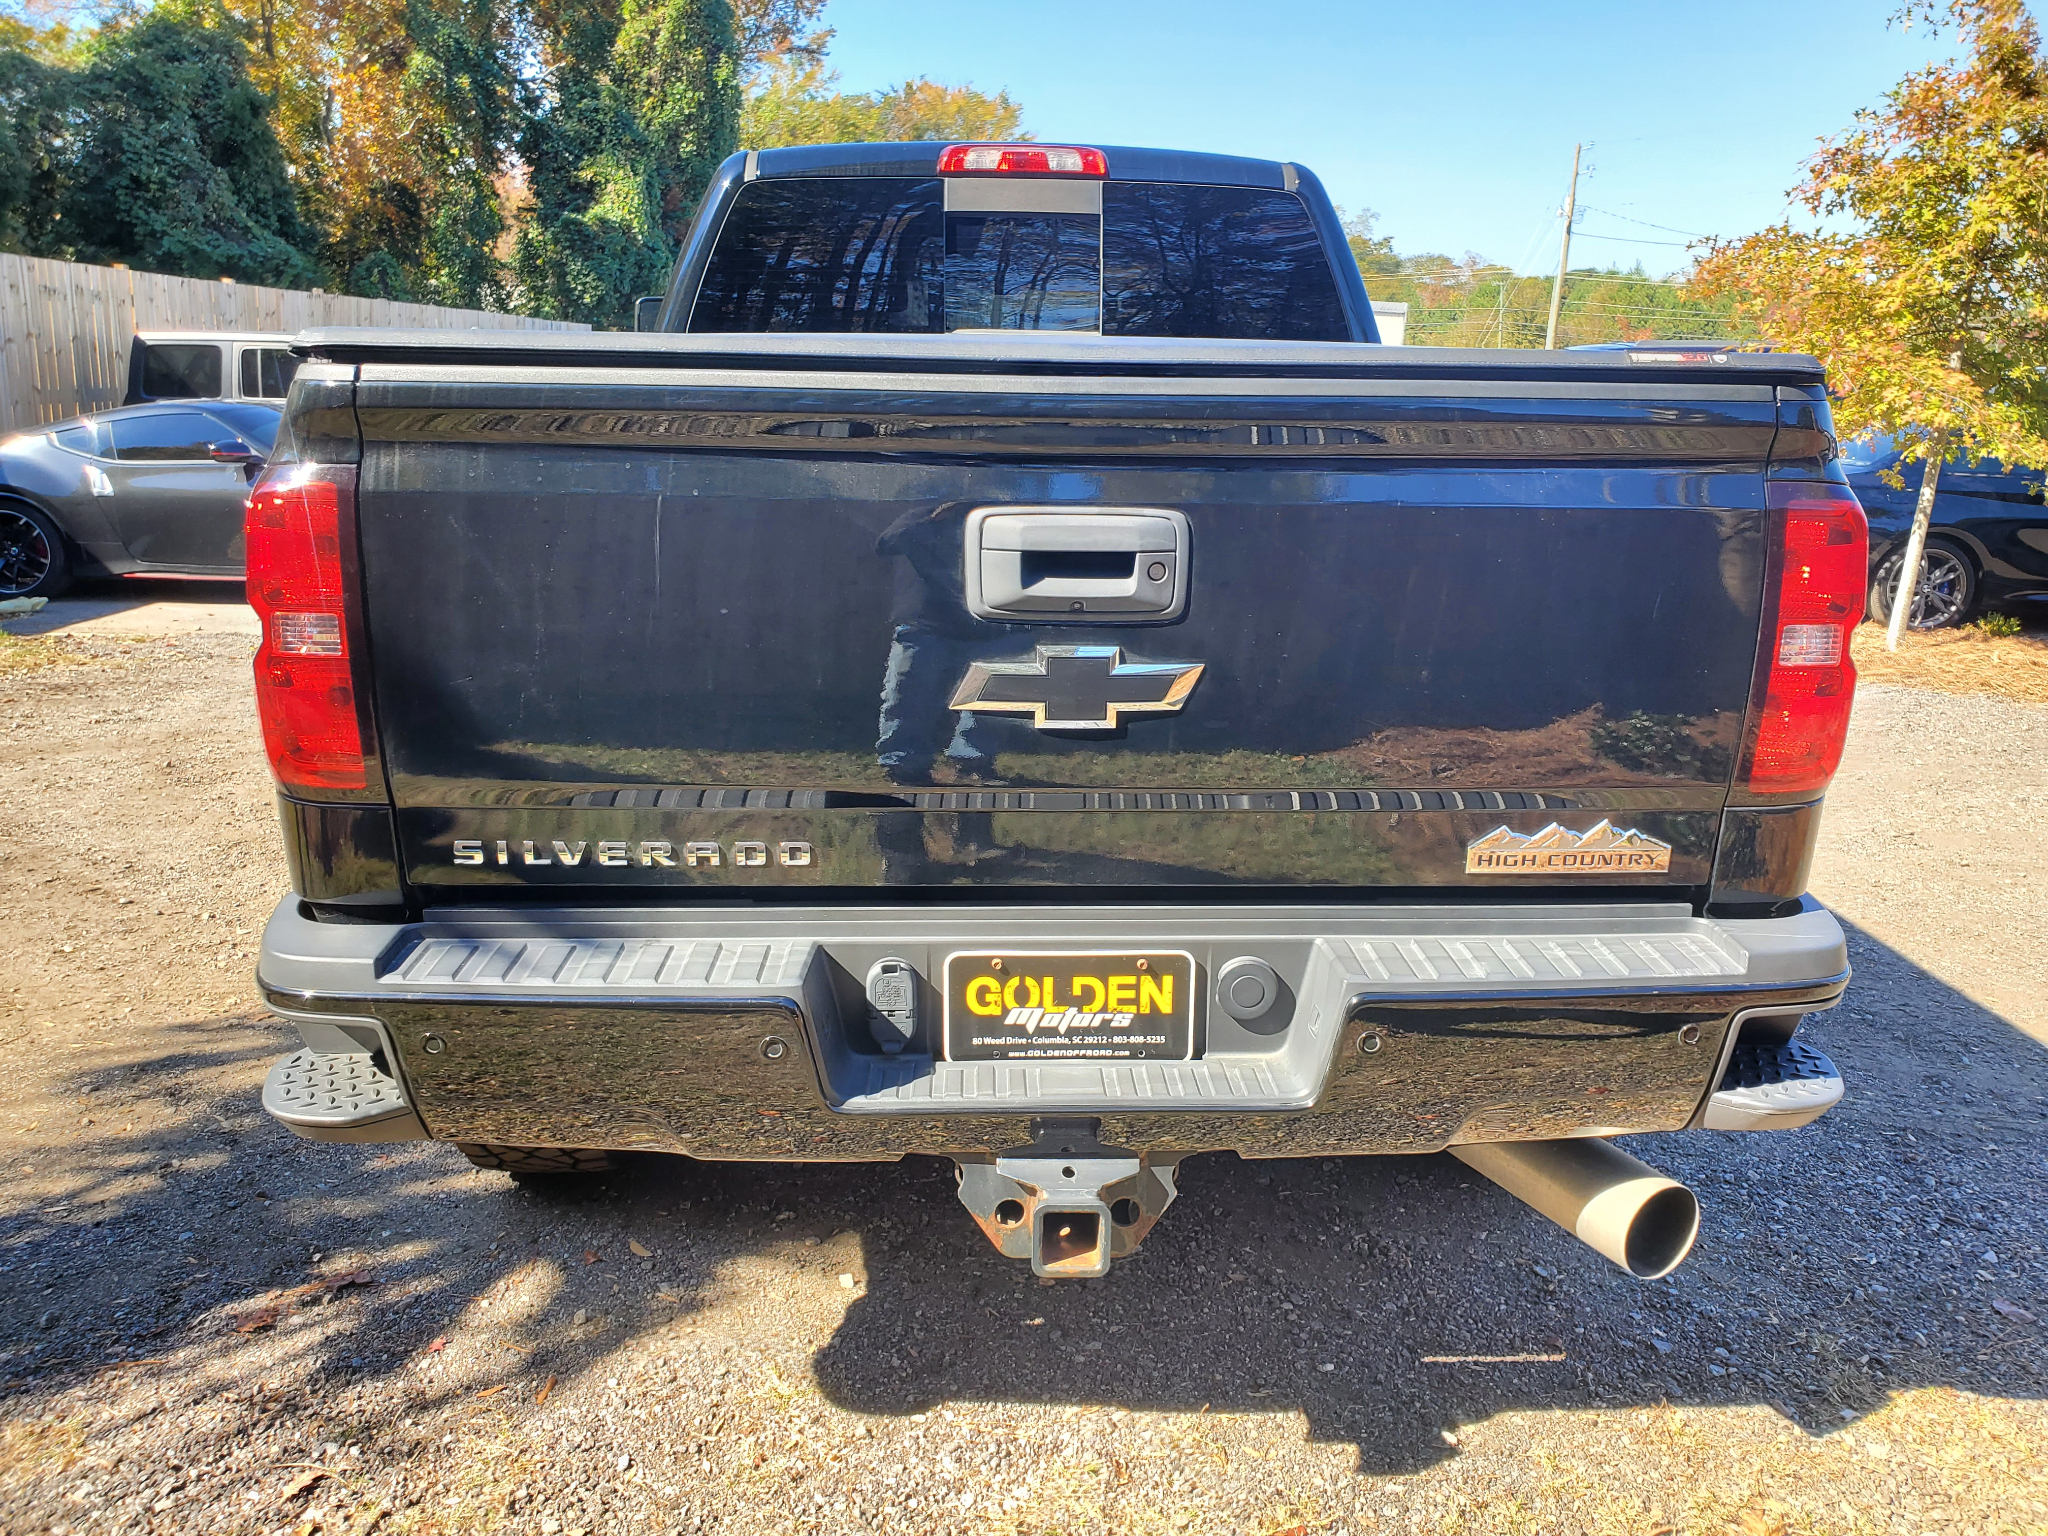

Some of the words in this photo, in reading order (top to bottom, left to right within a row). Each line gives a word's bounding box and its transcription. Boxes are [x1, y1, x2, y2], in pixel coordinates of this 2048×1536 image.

[453, 839, 812, 867] SILVERADO
[1477, 854, 1537, 867] HIGH
[1546, 853, 1662, 867] COUNTRY
[966, 974, 1174, 1016] GOLDEN
[1003, 1006, 1136, 1035] Motors
[972, 1037, 983, 1046] 80
[983, 1036, 1006, 1045] Weed
[1006, 1036, 1028, 1045] Drive
[1032, 1035, 1072, 1045] Columbia,
[1072, 1035, 1083, 1044] SC
[1083, 1035, 1108, 1044] 29212
[1112, 1035, 1166, 1044] 803-808-5235
